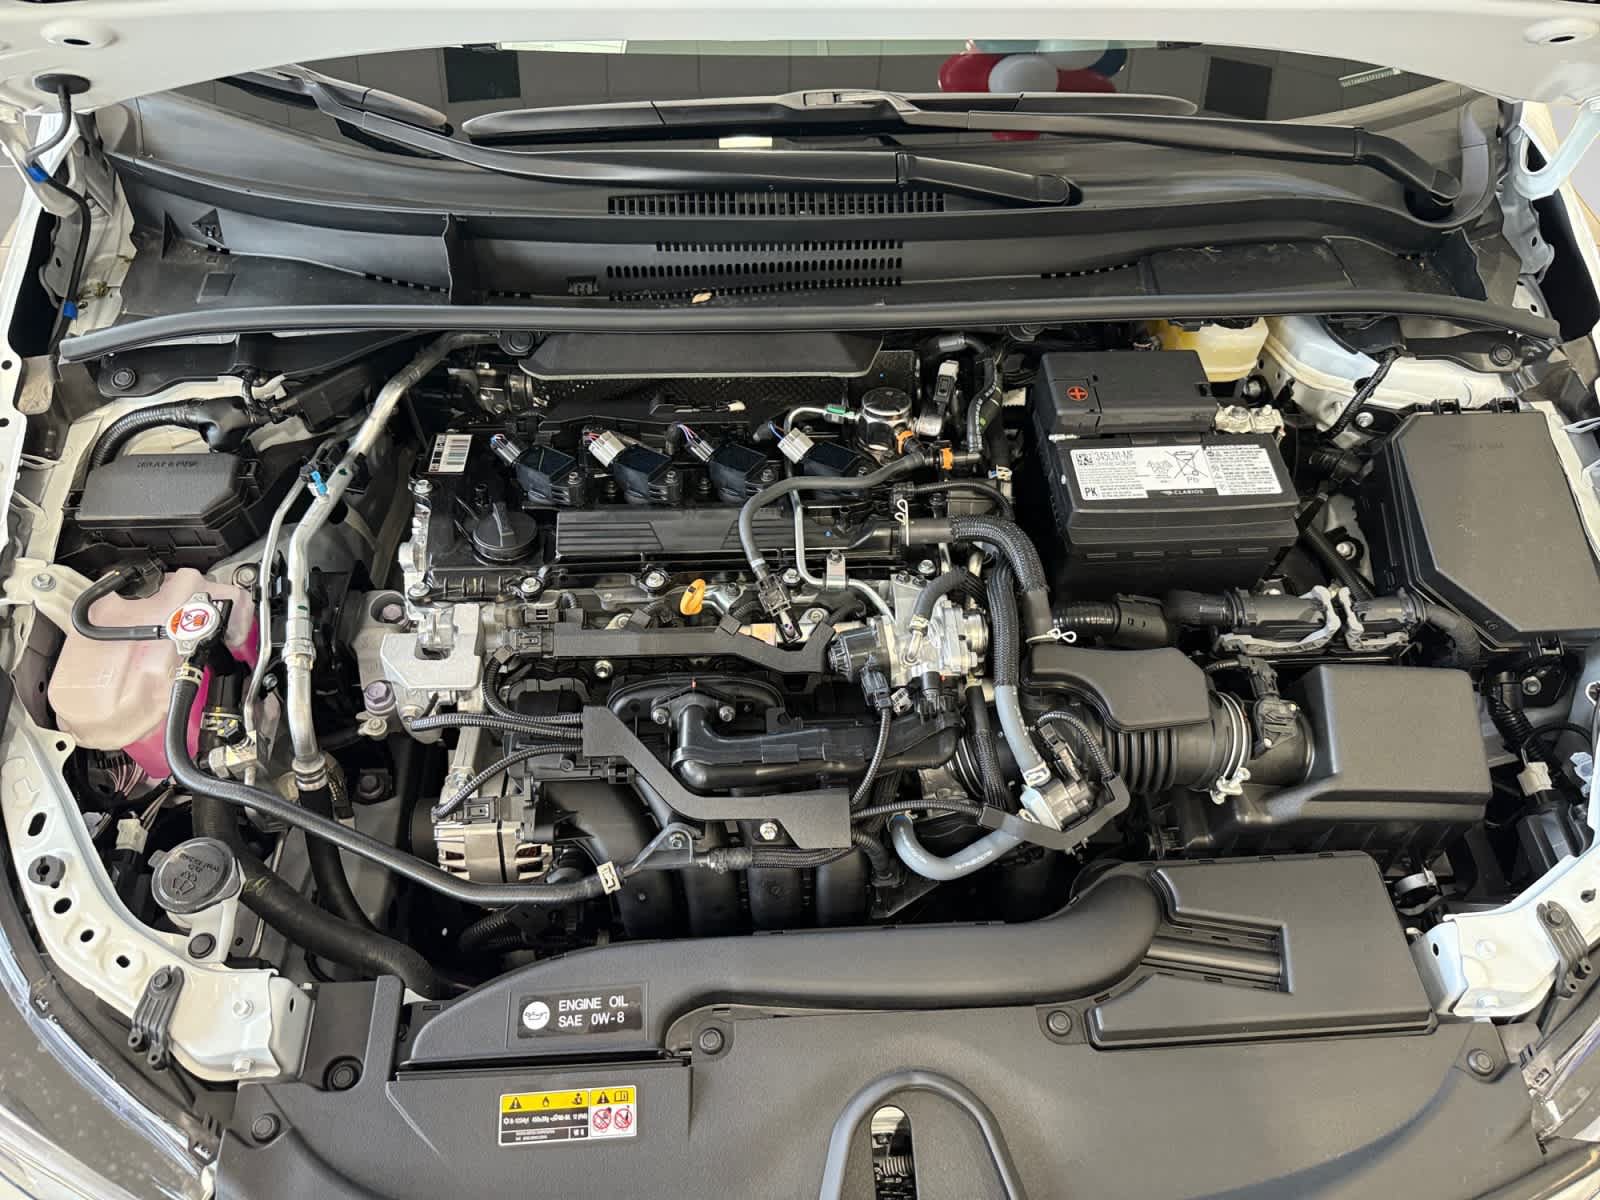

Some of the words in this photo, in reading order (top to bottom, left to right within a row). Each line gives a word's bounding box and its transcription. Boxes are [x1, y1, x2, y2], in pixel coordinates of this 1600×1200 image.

[1084, 487, 1098, 497] PK
[558, 997, 602, 1012] ENGINE
[608, 995, 629, 1008] OIL
[558, 1014, 583, 1028] SAE
[591, 1011, 625, 1025] 0W-8
